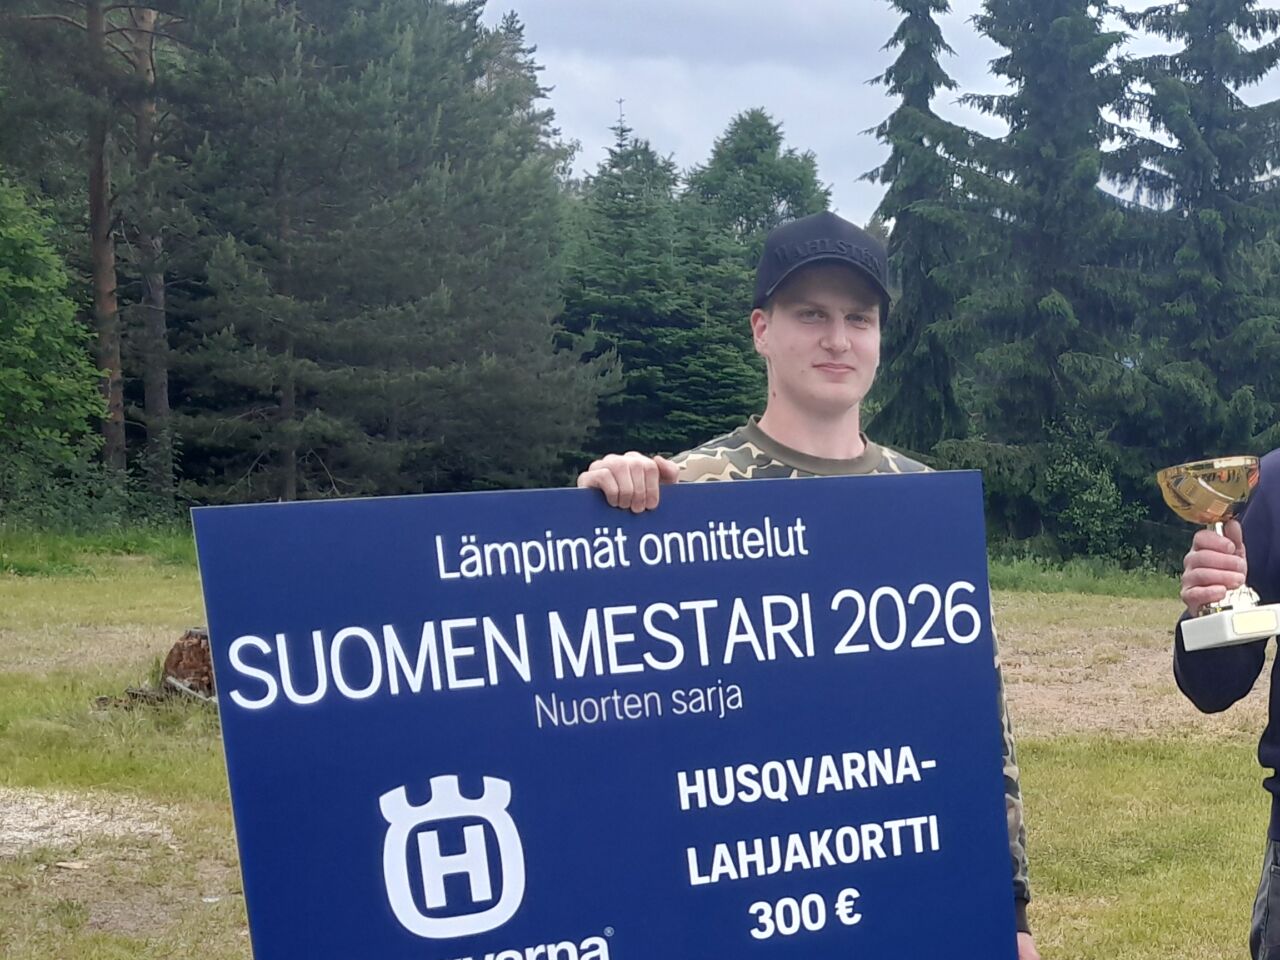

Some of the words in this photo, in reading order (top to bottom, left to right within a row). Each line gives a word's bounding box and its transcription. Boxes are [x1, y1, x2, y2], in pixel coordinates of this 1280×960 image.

[435, 527, 631, 584] Lämpimät
[639, 516, 809, 565] onnittelut
[228, 613, 532, 710] SUOMEN
[548, 592, 815, 679] MESTARI
[831, 581, 982, 655] 2026
[535, 689, 662, 728] Nuorten
[671, 679, 743, 719] sarja
[677, 746, 937, 811] HUSQVARNA-
[686, 814, 940, 886] LAHJAKORTTI
[748, 893, 827, 940] 300
[834, 887, 862, 926] €
